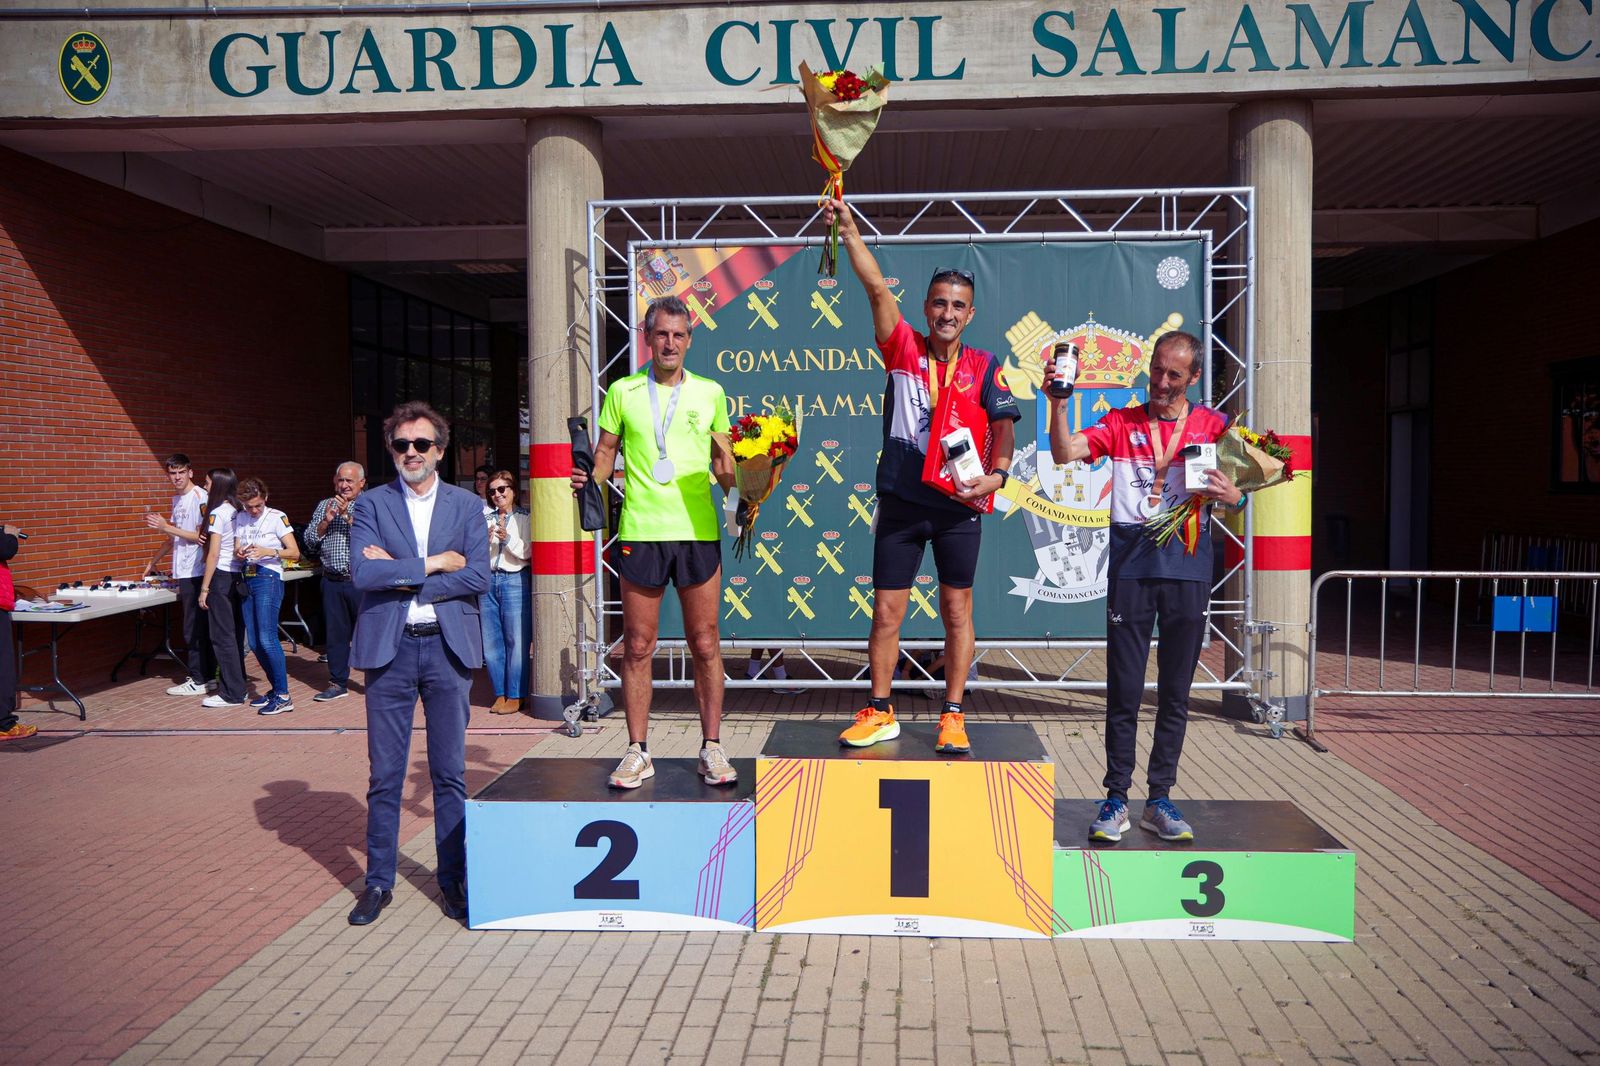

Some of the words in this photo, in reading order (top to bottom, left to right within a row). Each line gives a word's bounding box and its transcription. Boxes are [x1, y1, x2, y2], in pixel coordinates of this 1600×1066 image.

[209, 21, 643, 98] GUARDIA
[705, 15, 966, 86] CIVIL
[1031, 0, 1600, 78] SALAMANC
[716, 347, 886, 373] COMANDAN
[761, 393, 885, 418] SALAMA
[1025, 496, 1094, 523] COMANDANCIA
[1037, 588, 1098, 600] COMANDANCIA
[573, 819, 640, 900] 2
[879, 779, 930, 898] 1
[1180, 860, 1225, 918] 3
